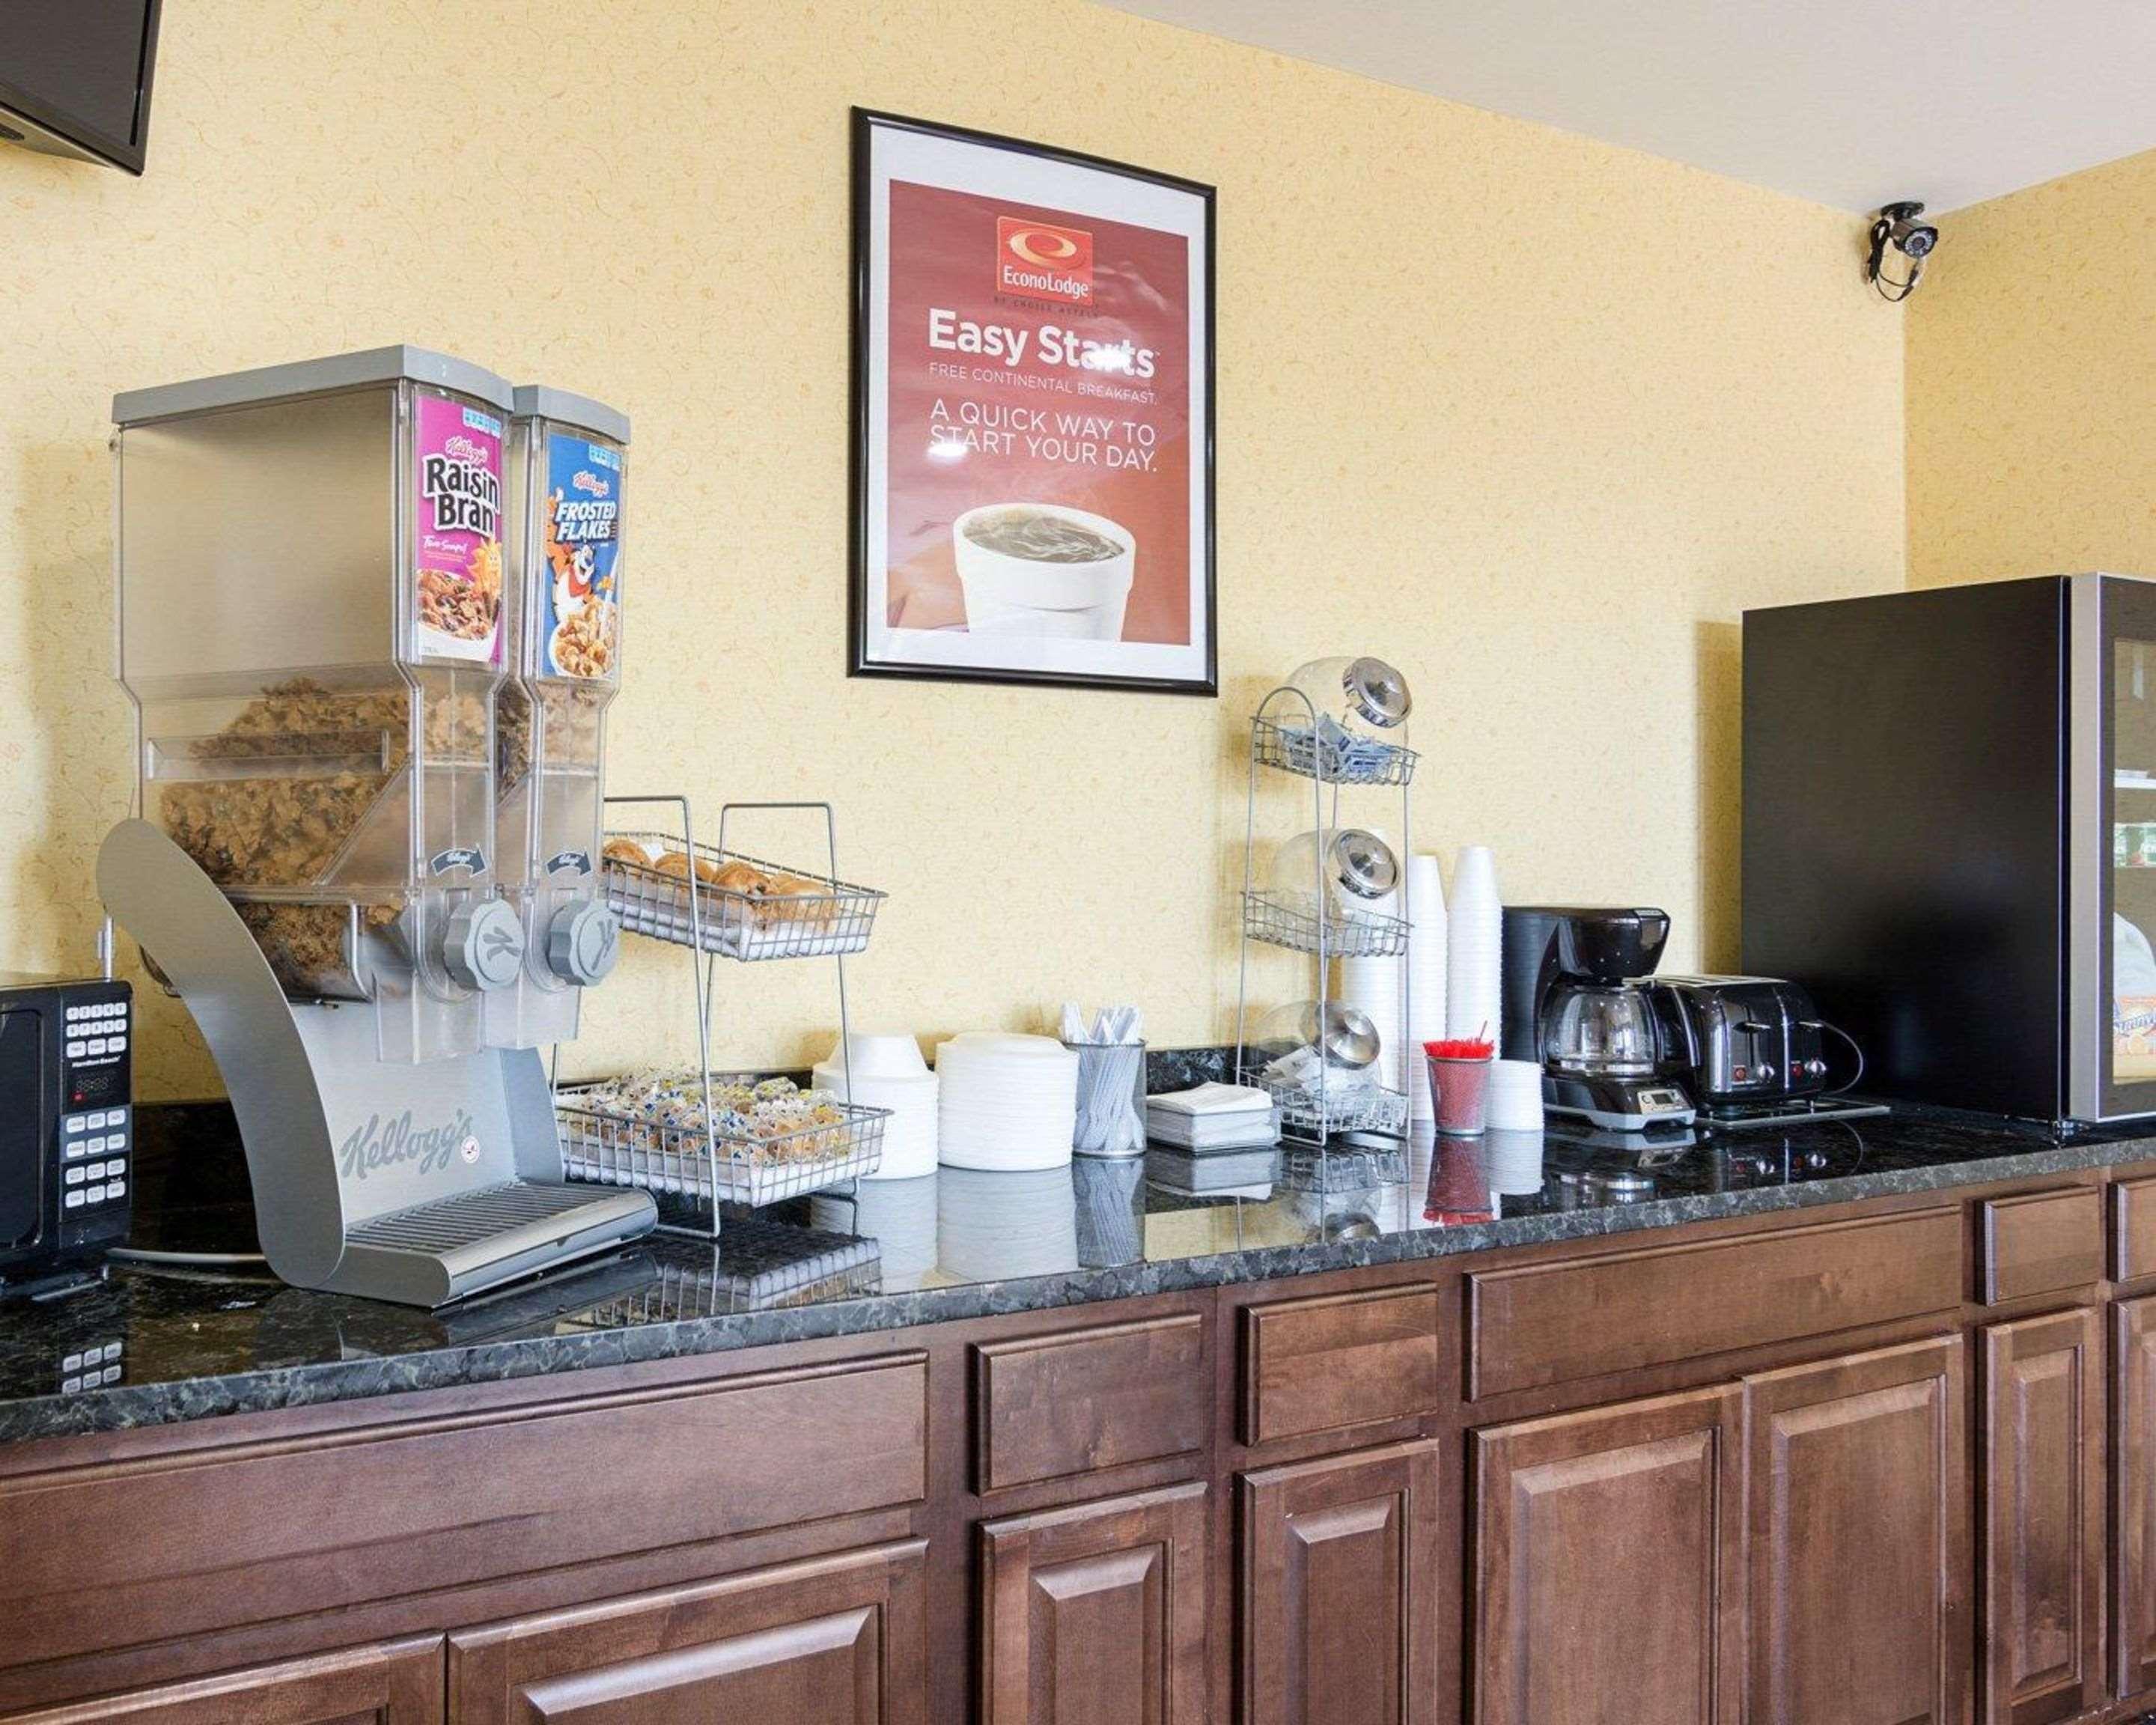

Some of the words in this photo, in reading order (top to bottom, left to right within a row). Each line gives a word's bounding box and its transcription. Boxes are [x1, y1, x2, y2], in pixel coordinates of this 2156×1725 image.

[1003, 265, 1089, 299] EconoLodge
[929, 308, 1029, 367] Easy
[929, 362, 967, 380] FREE
[972, 368, 1073, 394] CONTINENTAL
[930, 398, 950, 422] A
[960, 401, 1047, 433] QUICK
[1056, 413, 1115, 441] WAY
[1122, 422, 1156, 447] TO
[928, 423, 1017, 455] START
[1025, 436, 1097, 466] YOUR
[1106, 447, 1158, 473] DAY.
[425, 456, 499, 511] Raisin
[437, 494, 494, 533] Bran
[555, 500, 616, 522] FROSTED
[555, 520, 612, 541] FLAKES
[340, 1108, 473, 1180] Kellogg's
